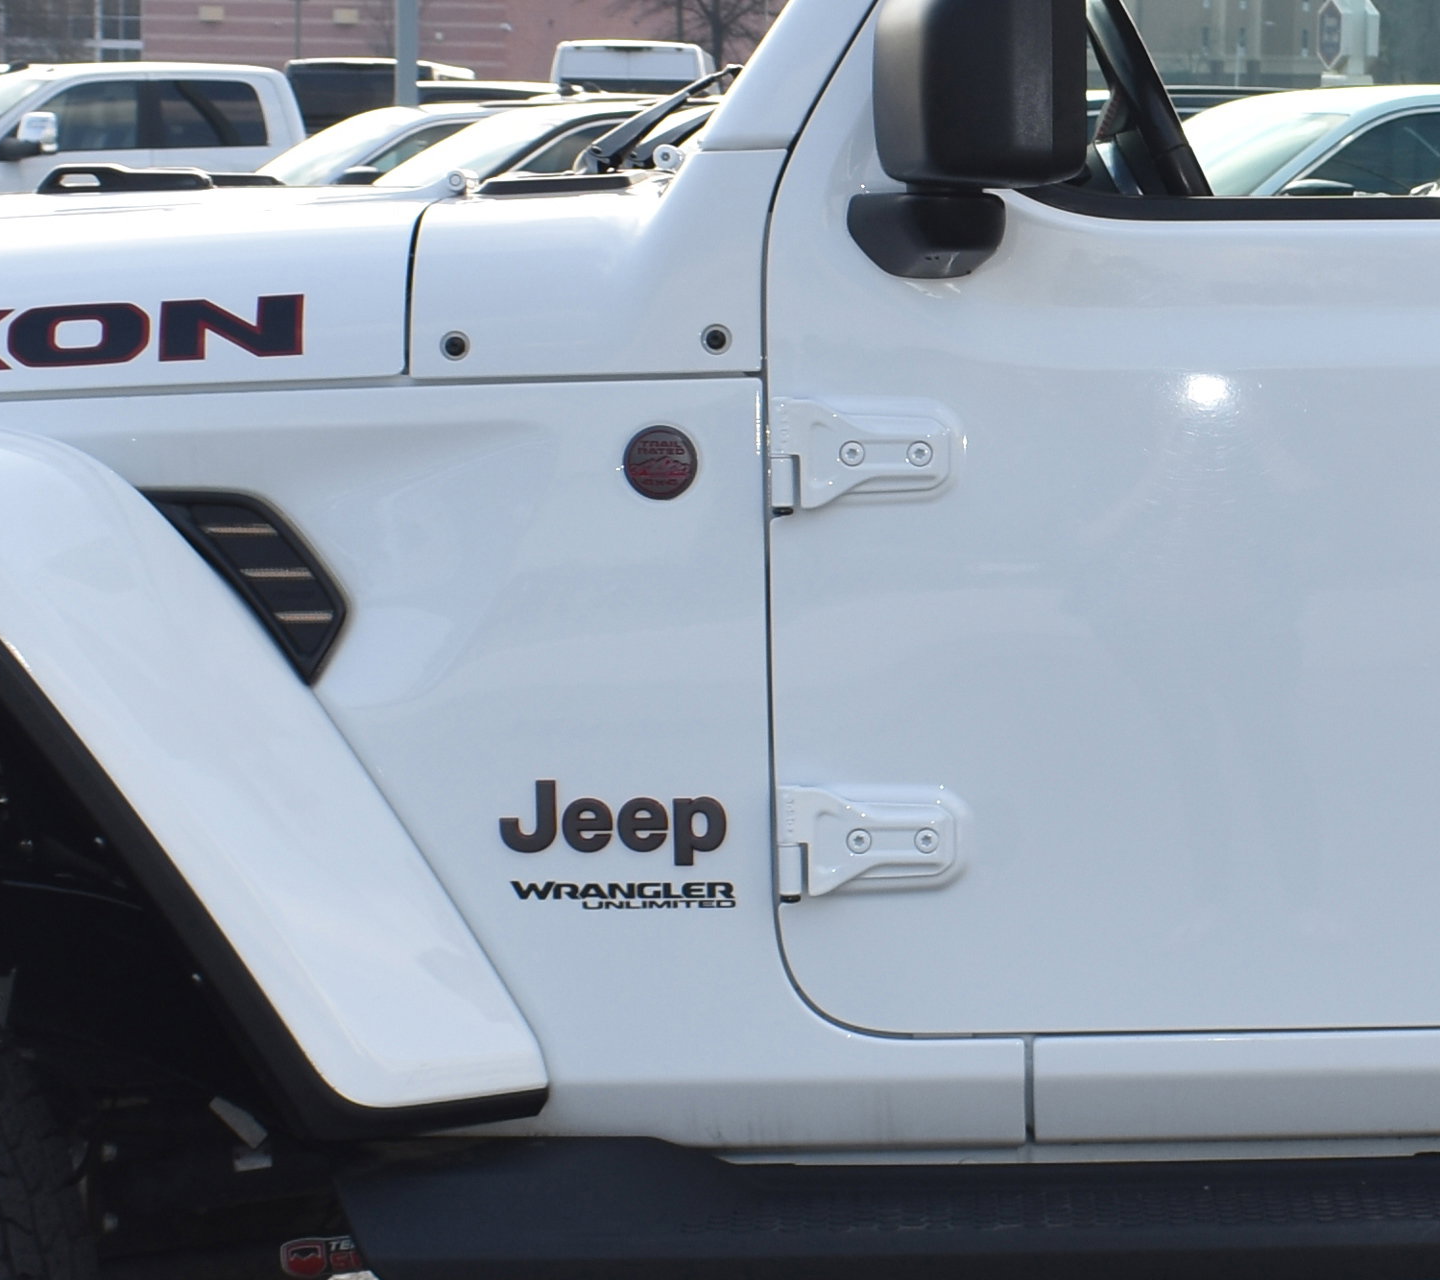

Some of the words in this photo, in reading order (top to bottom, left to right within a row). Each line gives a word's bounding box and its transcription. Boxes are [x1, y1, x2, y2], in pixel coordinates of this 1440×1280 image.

[639, 440, 681, 448] TRAIL
[637, 447, 685, 456] RATED
[498, 779, 728, 867] Jeep
[510, 880, 736, 900] WRANGLER
[581, 899, 737, 910] UNLIMITED
